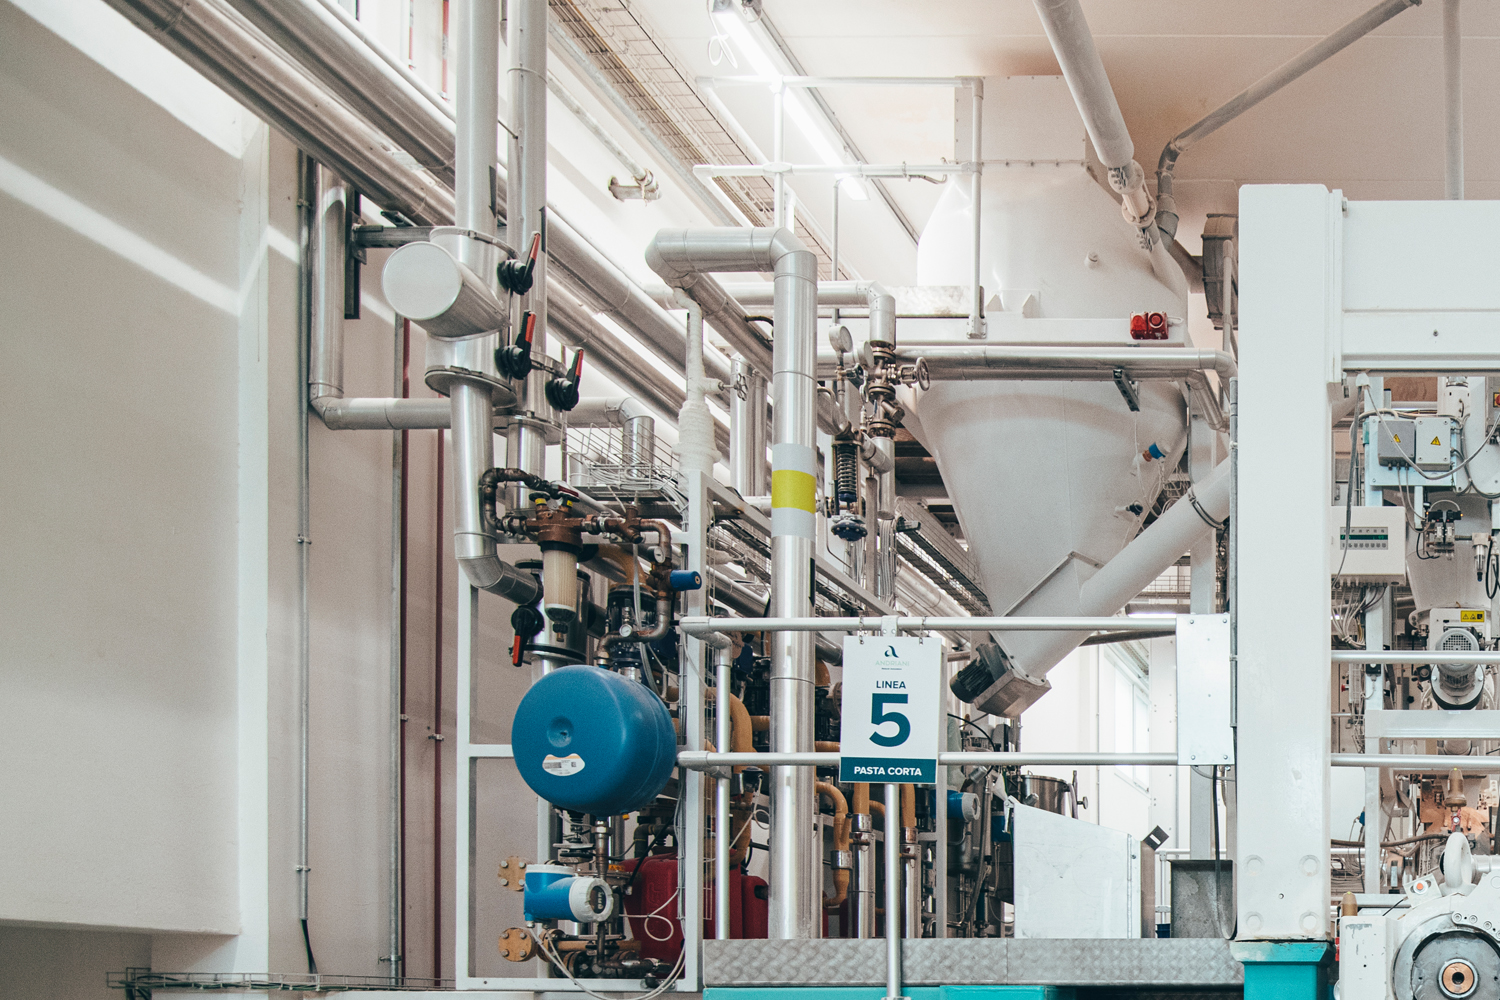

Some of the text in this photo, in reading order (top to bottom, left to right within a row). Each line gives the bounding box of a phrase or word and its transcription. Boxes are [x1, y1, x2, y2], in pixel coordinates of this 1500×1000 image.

[876, 680, 906, 689] LINEA
[869, 693, 911, 747] 5
[854, 766, 922, 776] PASTA CORTA
